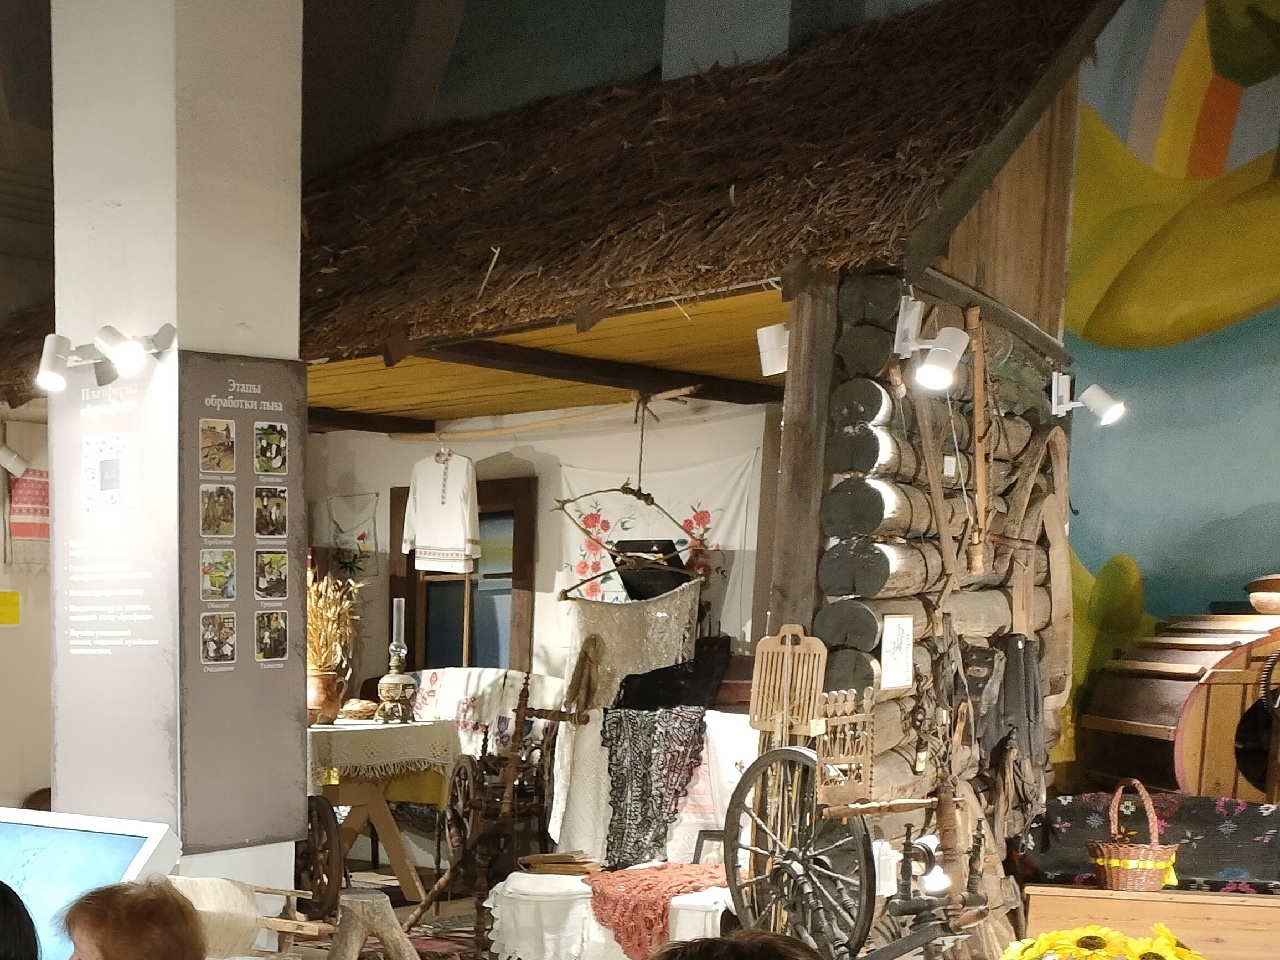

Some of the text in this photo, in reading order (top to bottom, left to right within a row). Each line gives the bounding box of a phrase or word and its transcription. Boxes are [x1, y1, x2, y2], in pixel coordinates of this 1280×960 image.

[227, 379, 261, 394] Этапы
[204, 394, 284, 411] обработки льна
